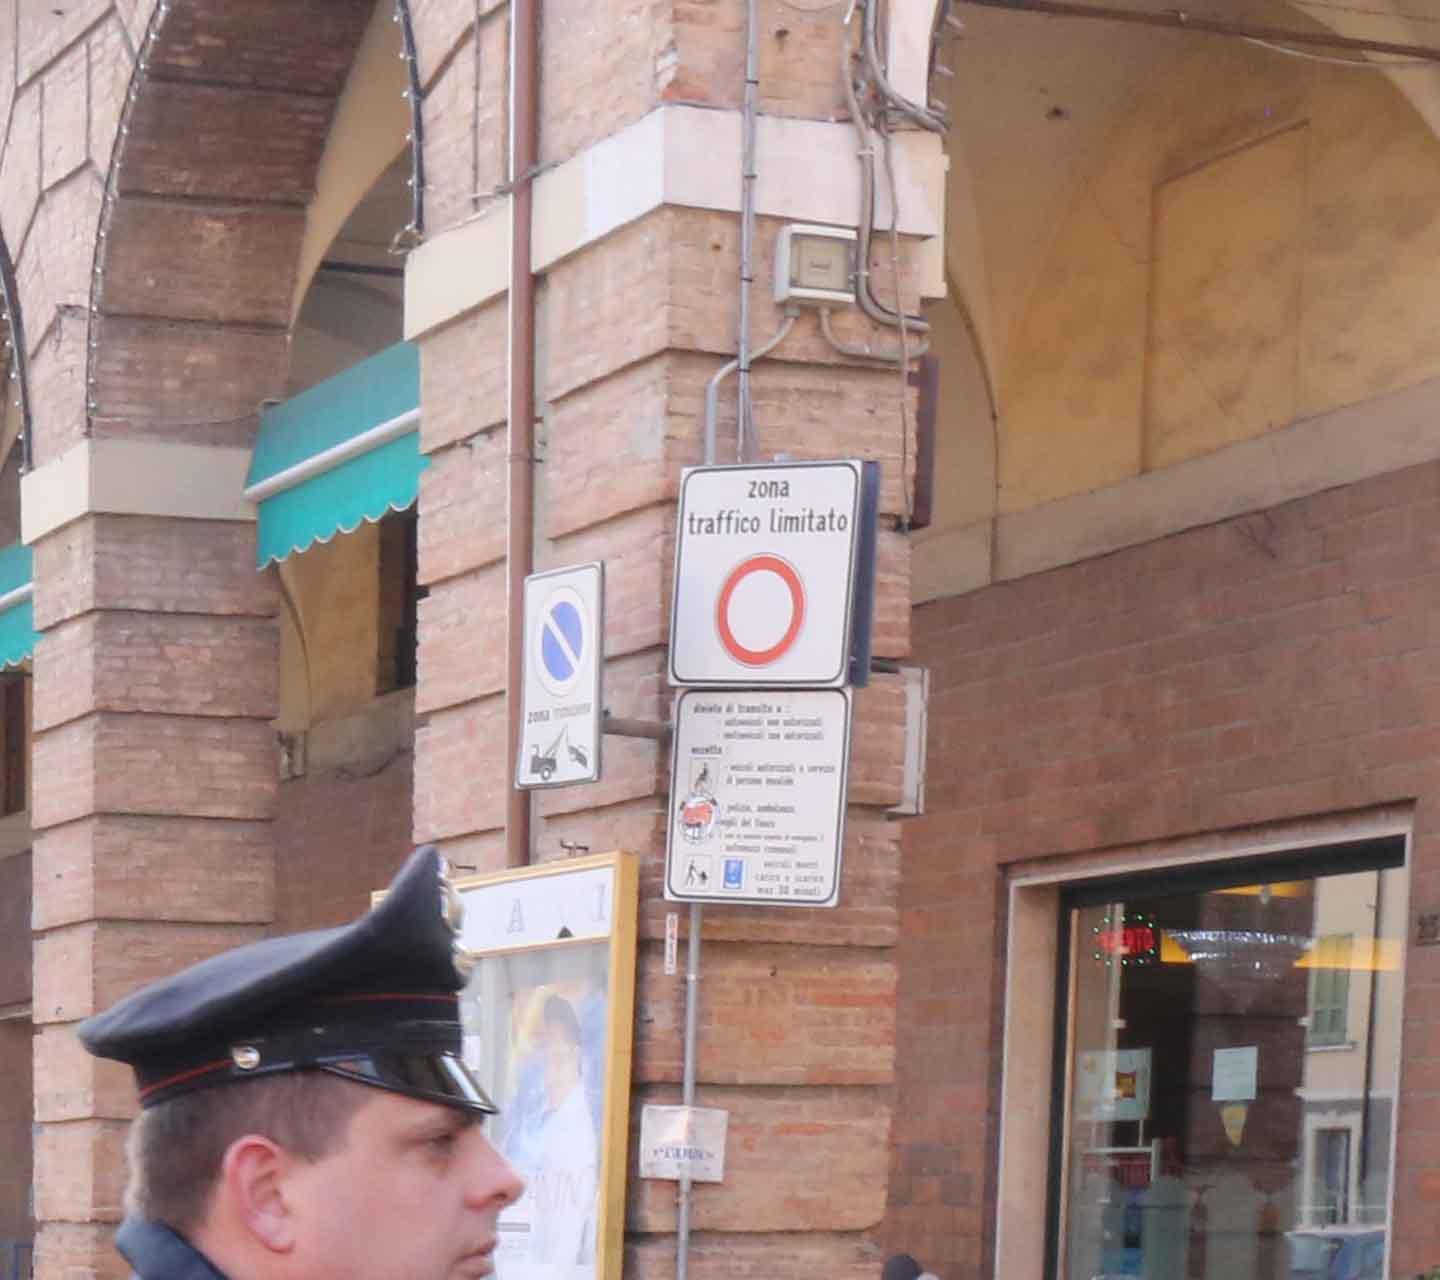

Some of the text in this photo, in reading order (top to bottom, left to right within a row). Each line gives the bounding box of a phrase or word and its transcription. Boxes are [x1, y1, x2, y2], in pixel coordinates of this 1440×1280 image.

[748, 480, 790, 499] zona
[688, 507, 848, 535] traffico limitato
